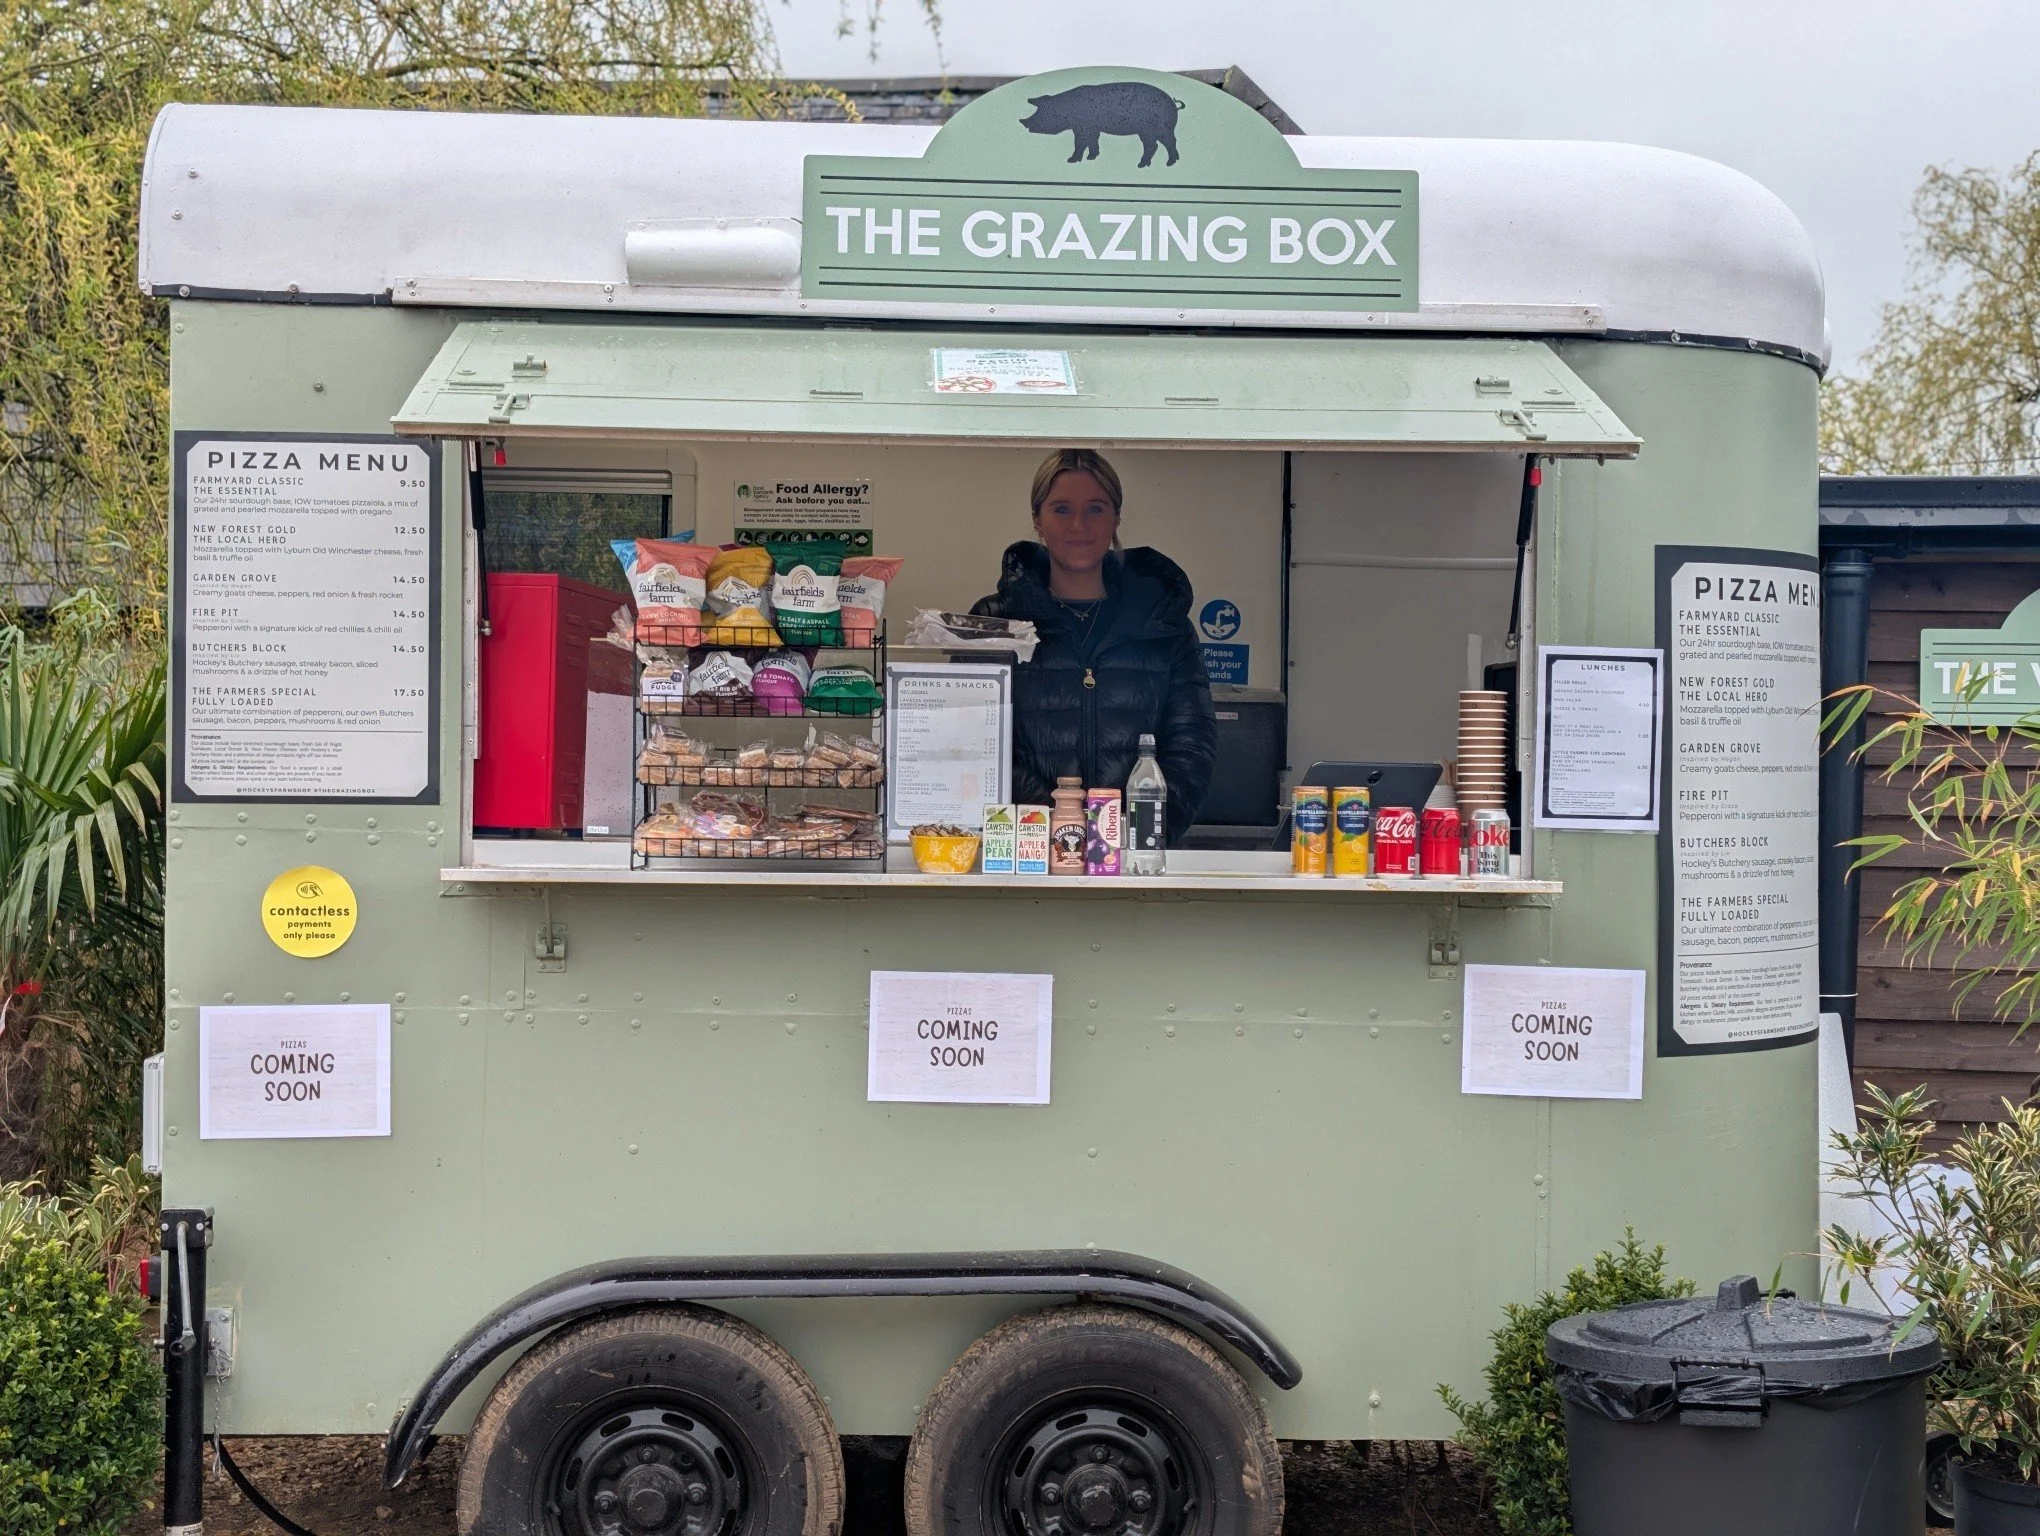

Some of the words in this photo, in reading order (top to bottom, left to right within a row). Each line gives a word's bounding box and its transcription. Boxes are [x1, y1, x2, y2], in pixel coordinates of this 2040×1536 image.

[825, 206, 941, 255] THE
[961, 210, 1248, 264] GRAZING
[1270, 217, 1397, 266] BOX
[208, 451, 301, 470] PIZZA
[320, 453, 408, 472] MENU
[193, 476, 252, 485] FARMYARD
[258, 477, 304, 486] CLASSIC
[400, 480, 425, 488] 9.50
[194, 486, 213, 495] THE
[219, 487, 277, 496] ESSENTIAL
[776, 483, 809, 494] Food
[813, 484, 869, 496] Allergy?
[795, 497, 826, 505] before
[193, 525, 216, 533] NEW
[222, 525, 262, 533] FOREST
[268, 526, 296, 534] GOLD
[394, 527, 425, 535] 12.50
[193, 535, 212, 543] THE
[218, 536, 253, 544] LOCAL
[259, 536, 286, 545] HERO
[193, 574, 236, 582] GARDEN
[241, 574, 277, 582] GROVE
[393, 576, 425, 584] 14.50
[193, 589, 222, 597] Creamy
[358, 591, 378, 599] fresh
[781, 586, 825, 597] fairfields
[1695, 577, 1778, 603] PIZZA
[649, 594, 674, 603] farm
[793, 597, 815, 607] farm
[192, 608, 216, 617] FIRE
[221, 609, 239, 617] PIT
[393, 610, 425, 619] 14.50
[1679, 610, 1740, 622] FARMYARD
[1744, 612, 1780, 624] CLASSIC
[1679, 624, 1701, 635] THE
[1706, 625, 1761, 637] ESSENTIAL
[192, 643, 247, 651] BUTCHERS
[252, 644, 287, 652] BLOCK
[1204, 649, 1234, 657] Please
[192, 659, 227, 667] Hockey's
[299, 660, 327, 668] streaky
[1221, 661, 1241, 669] your
[1581, 664, 1626, 672] LUNCHES
[254, 668, 279, 676] drizzle
[304, 669, 329, 677] honey
[1208, 671, 1232, 679] ands
[1679, 677, 1705, 687] NEW
[1710, 677, 1749, 688] FOREST
[1753, 678, 1775, 688] GOLD
[1934, 661, 2016, 695] THE
[192, 687, 212, 695] THE
[217, 687, 266, 695] FARMERS
[271, 687, 316, 696] SPECIAL
[393, 689, 424, 697] 17.50
[1679, 691, 1701, 701] THE
[1707, 691, 1740, 702] LOCAL
[1745, 692, 1768, 702] HERO
[192, 697, 225, 705] FULLY
[231, 698, 274, 706] LOADED
[242, 708, 292, 716] combination
[1679, 743, 1725, 753] GARDEN
[1730, 743, 1761, 753] GROVE
[1679, 791, 1705, 800] FIRE
[1711, 790, 1729, 800] PIT
[986, 823, 1013, 831] CAWSTON
[1018, 824, 1047, 832] CAWSTON
[1106, 805, 1117, 841] Ribena
[986, 839, 1005, 847] APPLE
[1019, 841, 1039, 849] APPLE
[1041, 841, 1046, 849] &
[1680, 837, 1737, 848] BUTCHERS
[1741, 836, 1769, 847] BLOCK
[985, 848, 1012, 858] PEAR
[1019, 850, 1045, 860] MANGO
[1480, 851, 1497, 859] This
[1681, 897, 1702, 908] THE
[1707, 895, 1753, 907] FARMERS
[1757, 894, 1788, 905] SPECIAL
[269, 905, 351, 917] contactless
[1681, 911, 1716, 922] FULLY
[1721, 909, 1760, 921] LOADED
[287, 920, 332, 929] payments
[283, 932, 303, 940] only
[305, 932, 336, 940] please
[1541, 1001, 1567, 1010] PIZZAS
[947, 1007, 973, 1015] PIZZAS
[1511, 1013, 1593, 1036] COMING
[917, 1019, 999, 1041] COMING
[280, 1040, 307, 1049] PIZZAS
[1524, 1040, 1579, 1061] SOON
[929, 1046, 985, 1067] SOON
[250, 1053, 335, 1075] COMING
[264, 1080, 321, 1102] SOON
